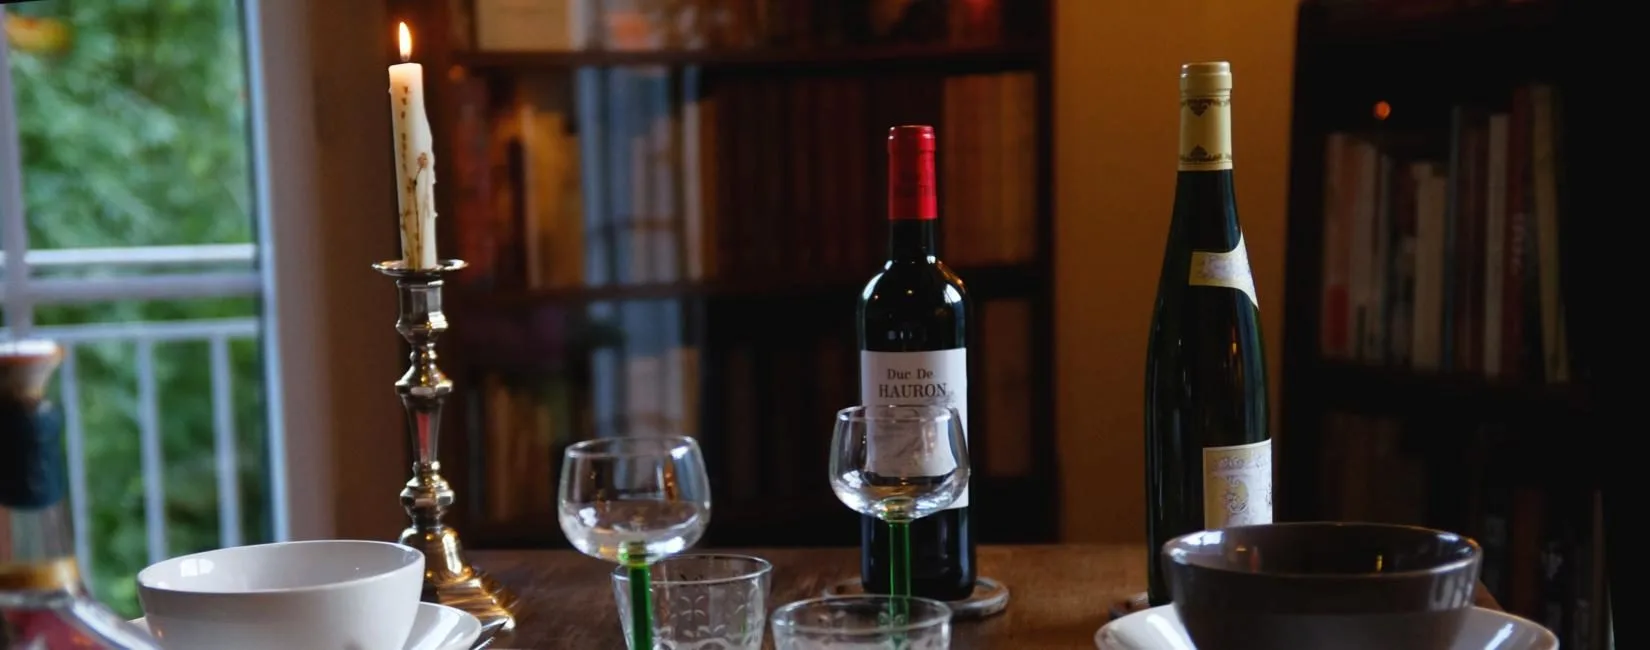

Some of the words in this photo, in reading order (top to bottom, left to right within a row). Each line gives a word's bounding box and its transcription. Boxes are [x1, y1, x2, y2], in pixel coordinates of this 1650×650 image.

[887, 368, 911, 380] Duc
[917, 367, 933, 380] De
[879, 382, 947, 398] HAURON
